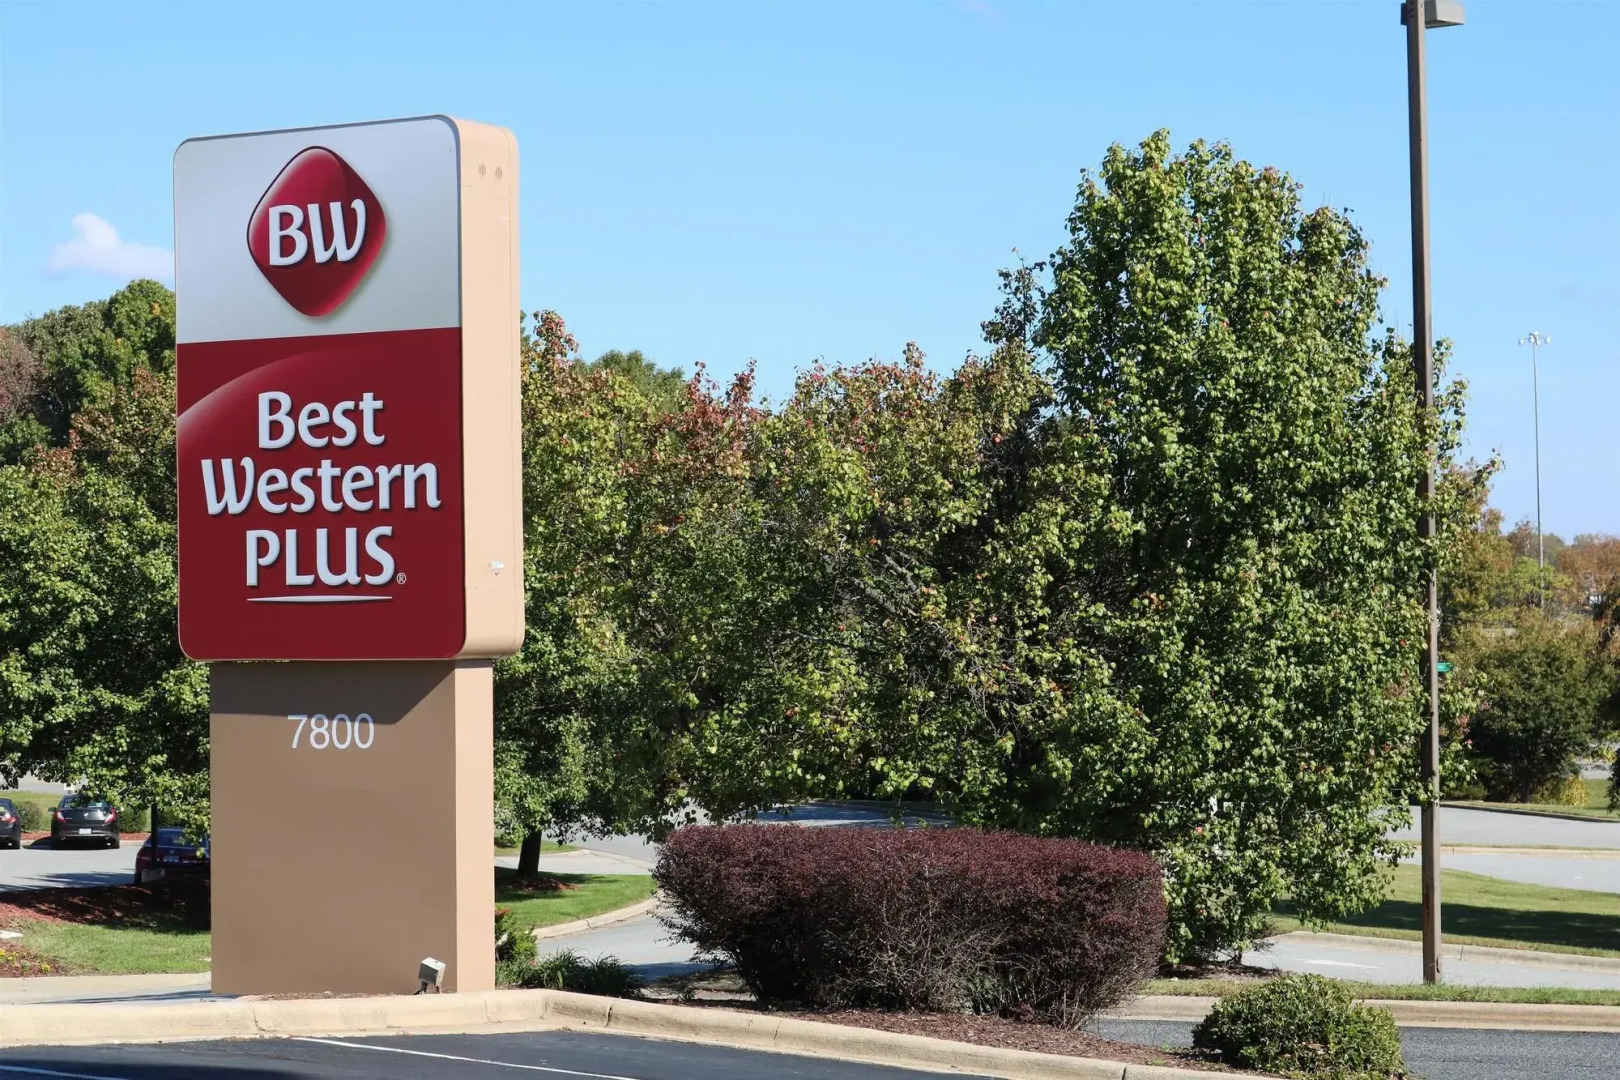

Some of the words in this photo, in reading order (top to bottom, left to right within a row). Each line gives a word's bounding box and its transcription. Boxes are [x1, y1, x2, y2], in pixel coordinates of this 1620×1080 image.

[268, 198, 366, 266] BW
[258, 391, 385, 449] Best
[201, 456, 441, 515] Western
[287, 713, 375, 749] 7800
